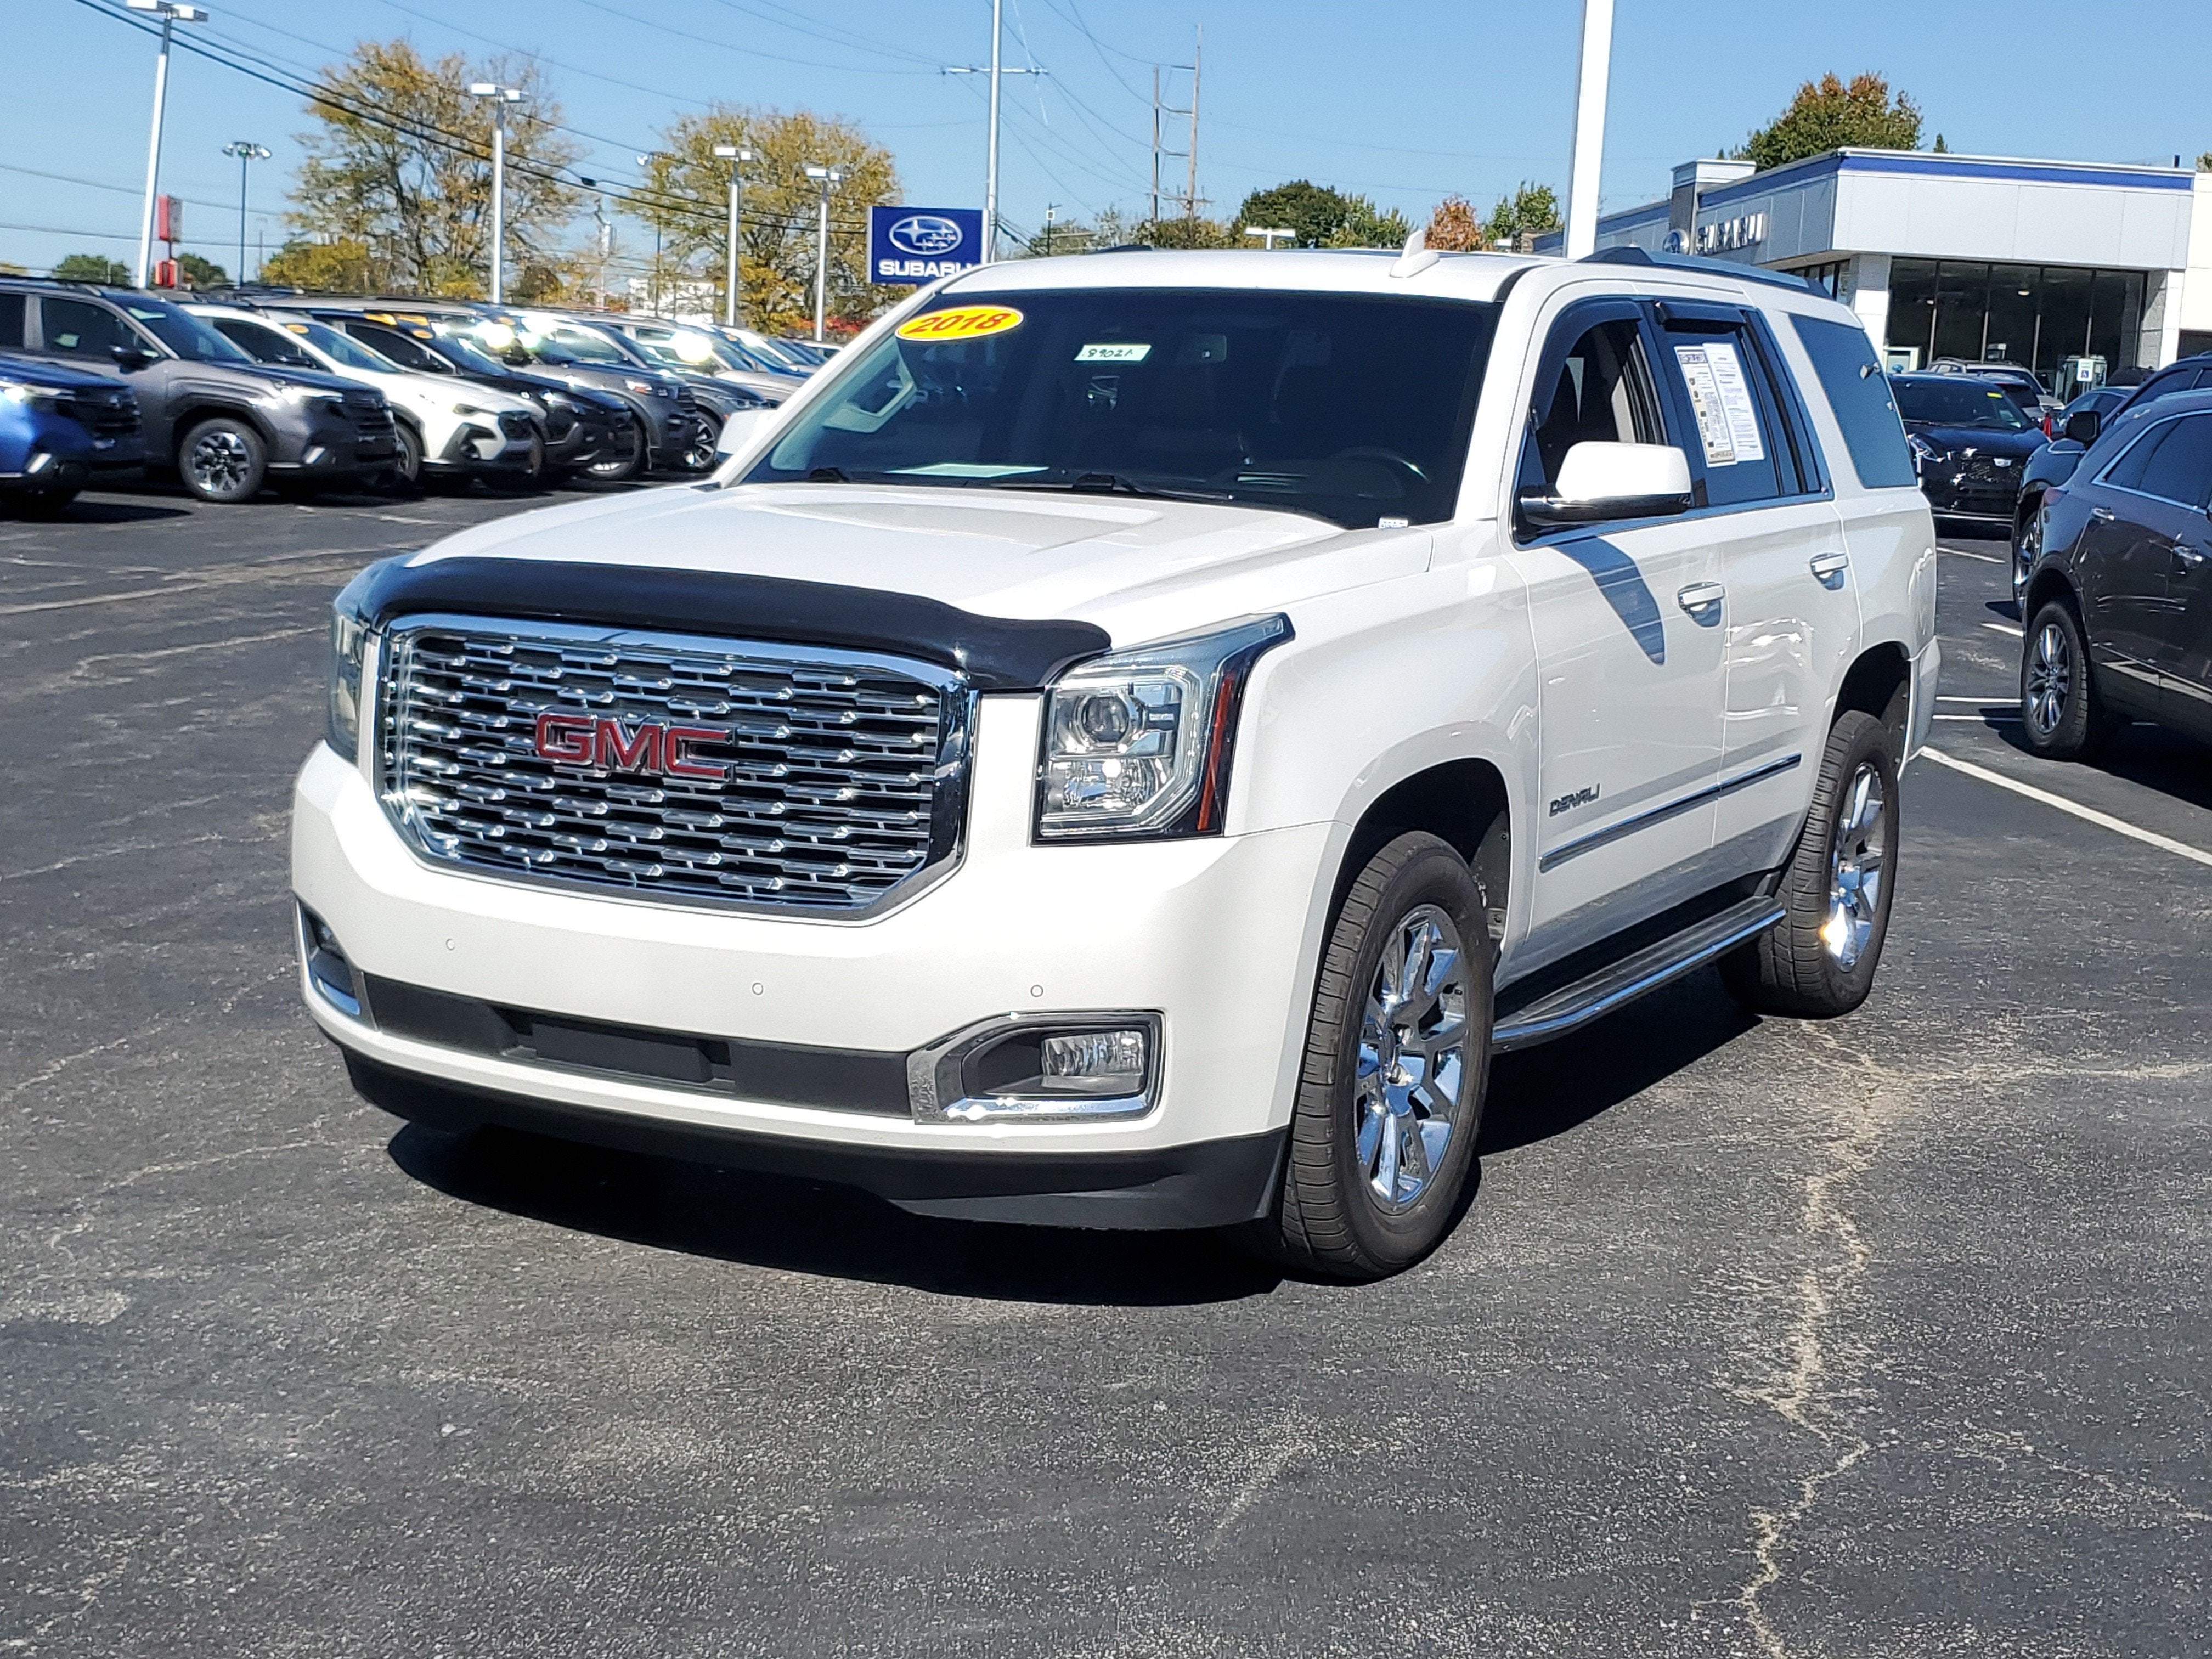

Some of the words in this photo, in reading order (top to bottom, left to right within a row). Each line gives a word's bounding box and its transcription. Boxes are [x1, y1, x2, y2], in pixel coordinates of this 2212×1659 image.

[904, 313, 1012, 334] 2018
[536, 713, 736, 782] GMC
[1549, 783, 1600, 817] DENALI
